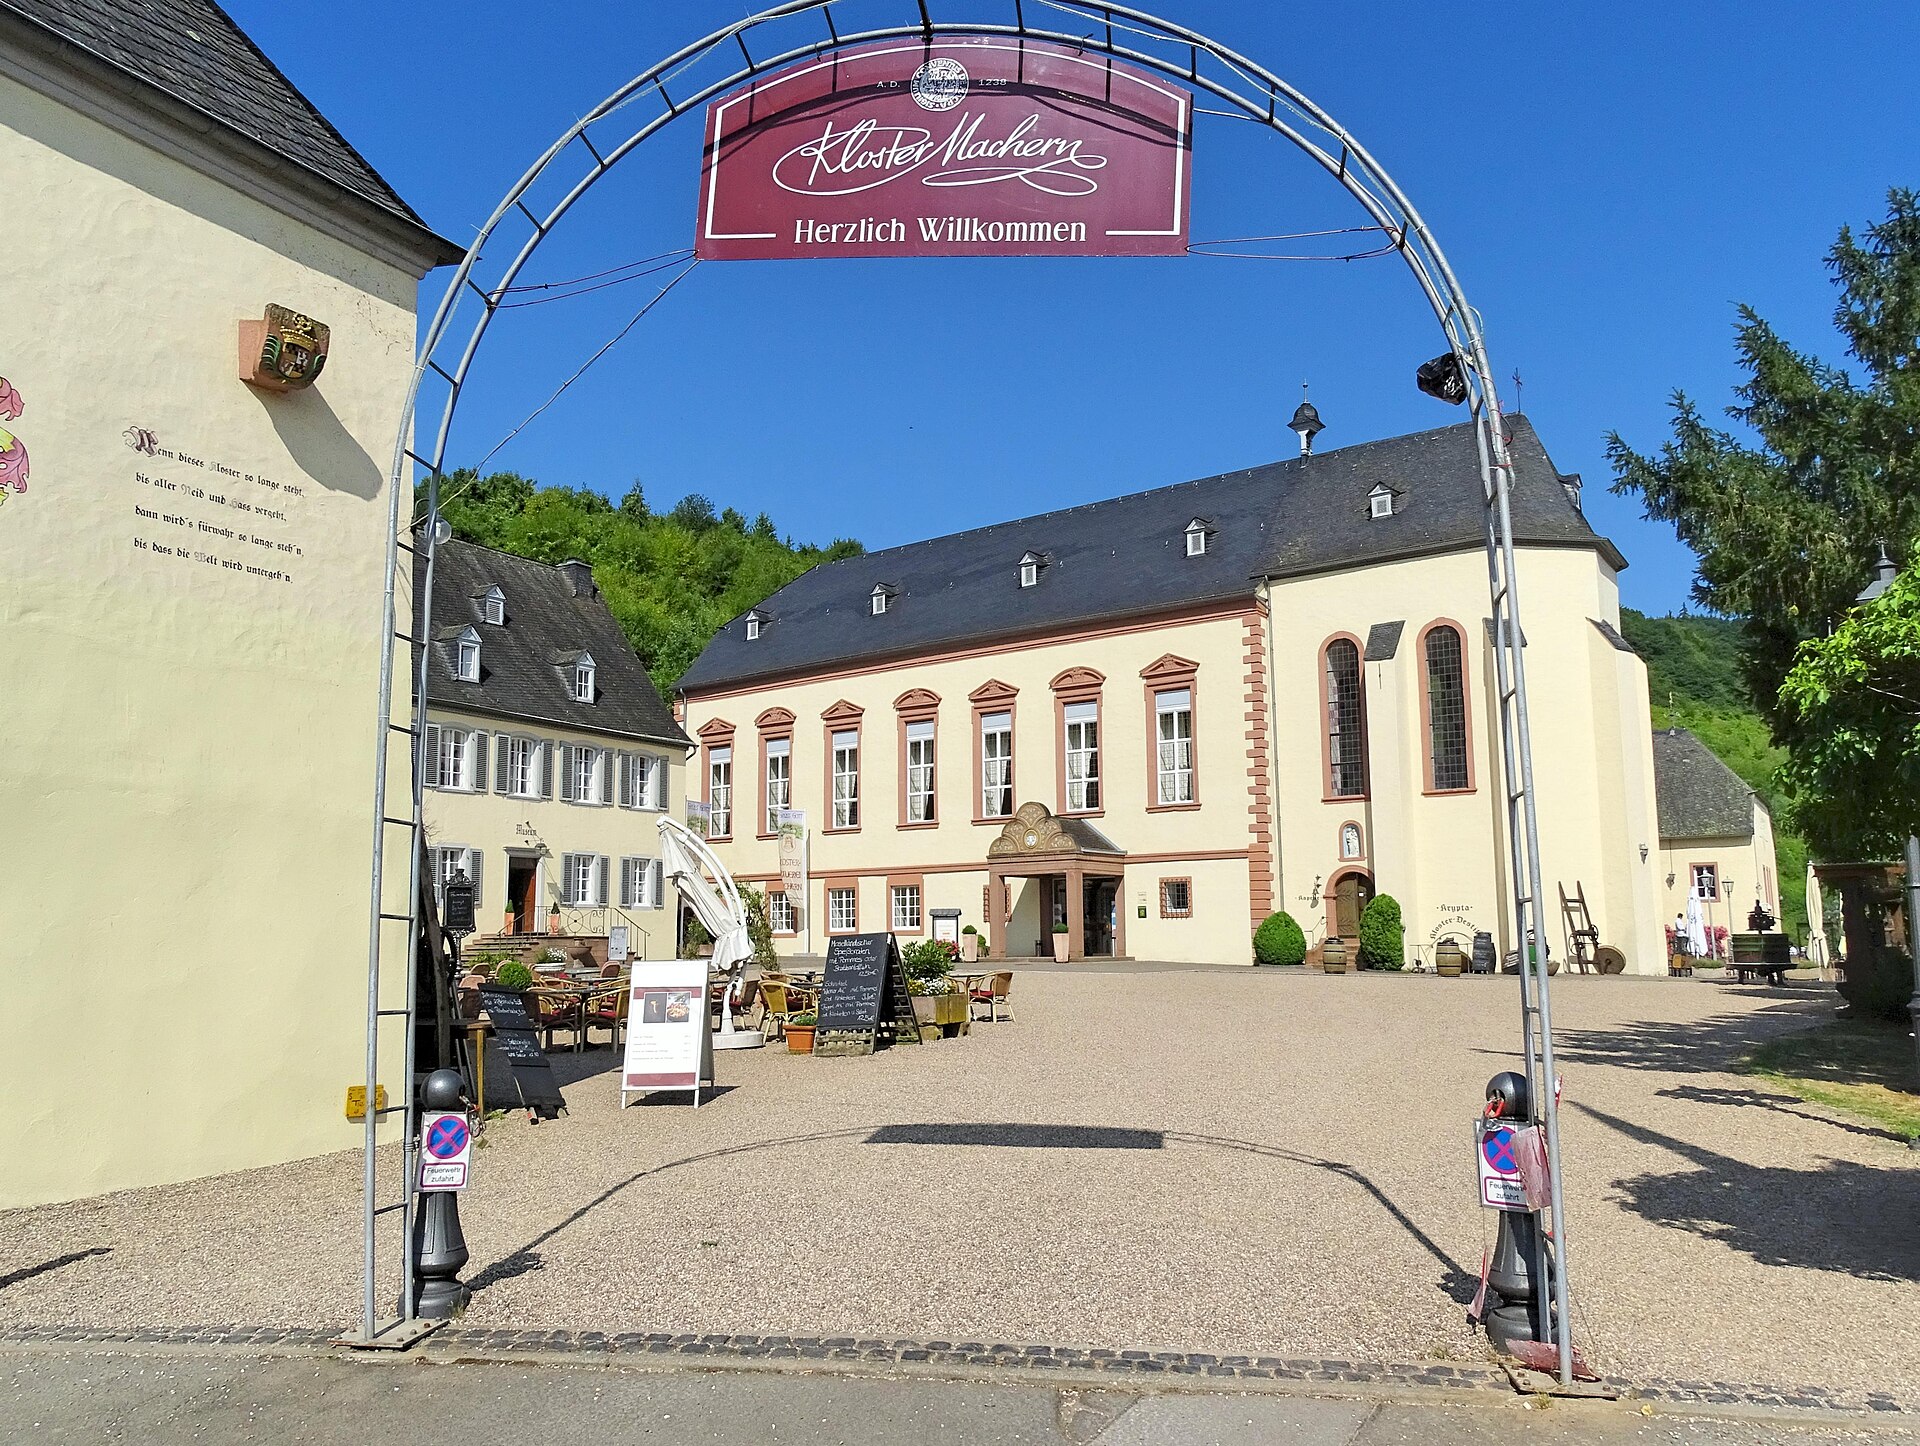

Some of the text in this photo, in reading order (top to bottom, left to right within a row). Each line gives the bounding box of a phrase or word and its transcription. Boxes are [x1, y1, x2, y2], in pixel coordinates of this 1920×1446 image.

[978, 78, 1008, 86] 1238
[772, 111, 1107, 195] Kloster Machern
[794, 216, 1088, 245] Herzlich Willkommen
[178, 452, 205, 468] dieses
[244, 473, 254, 482] so
[257, 475, 280, 490] lange
[135, 472, 150, 485] bis
[154, 478, 177, 491] aller
[209, 492, 226, 505] und
[135, 505, 158, 520] dann
[198, 520, 234, 540] fürwahr
[238, 533, 248, 542] so
[251, 535, 274, 549] lange
[134, 537, 148, 550] bis
[152, 541, 173, 555] dass
[176, 547, 191, 559] die
[222, 559, 243, 572] wird
[1440, 903, 1470, 913] Krypta
[426, 1166, 462, 1174] Feuerwehr
[431, 1175, 455, 1183] zufahrt
[1489, 1181, 1524, 1191] Feuerweh
[1496, 1193, 1520, 1201] zufahrt
